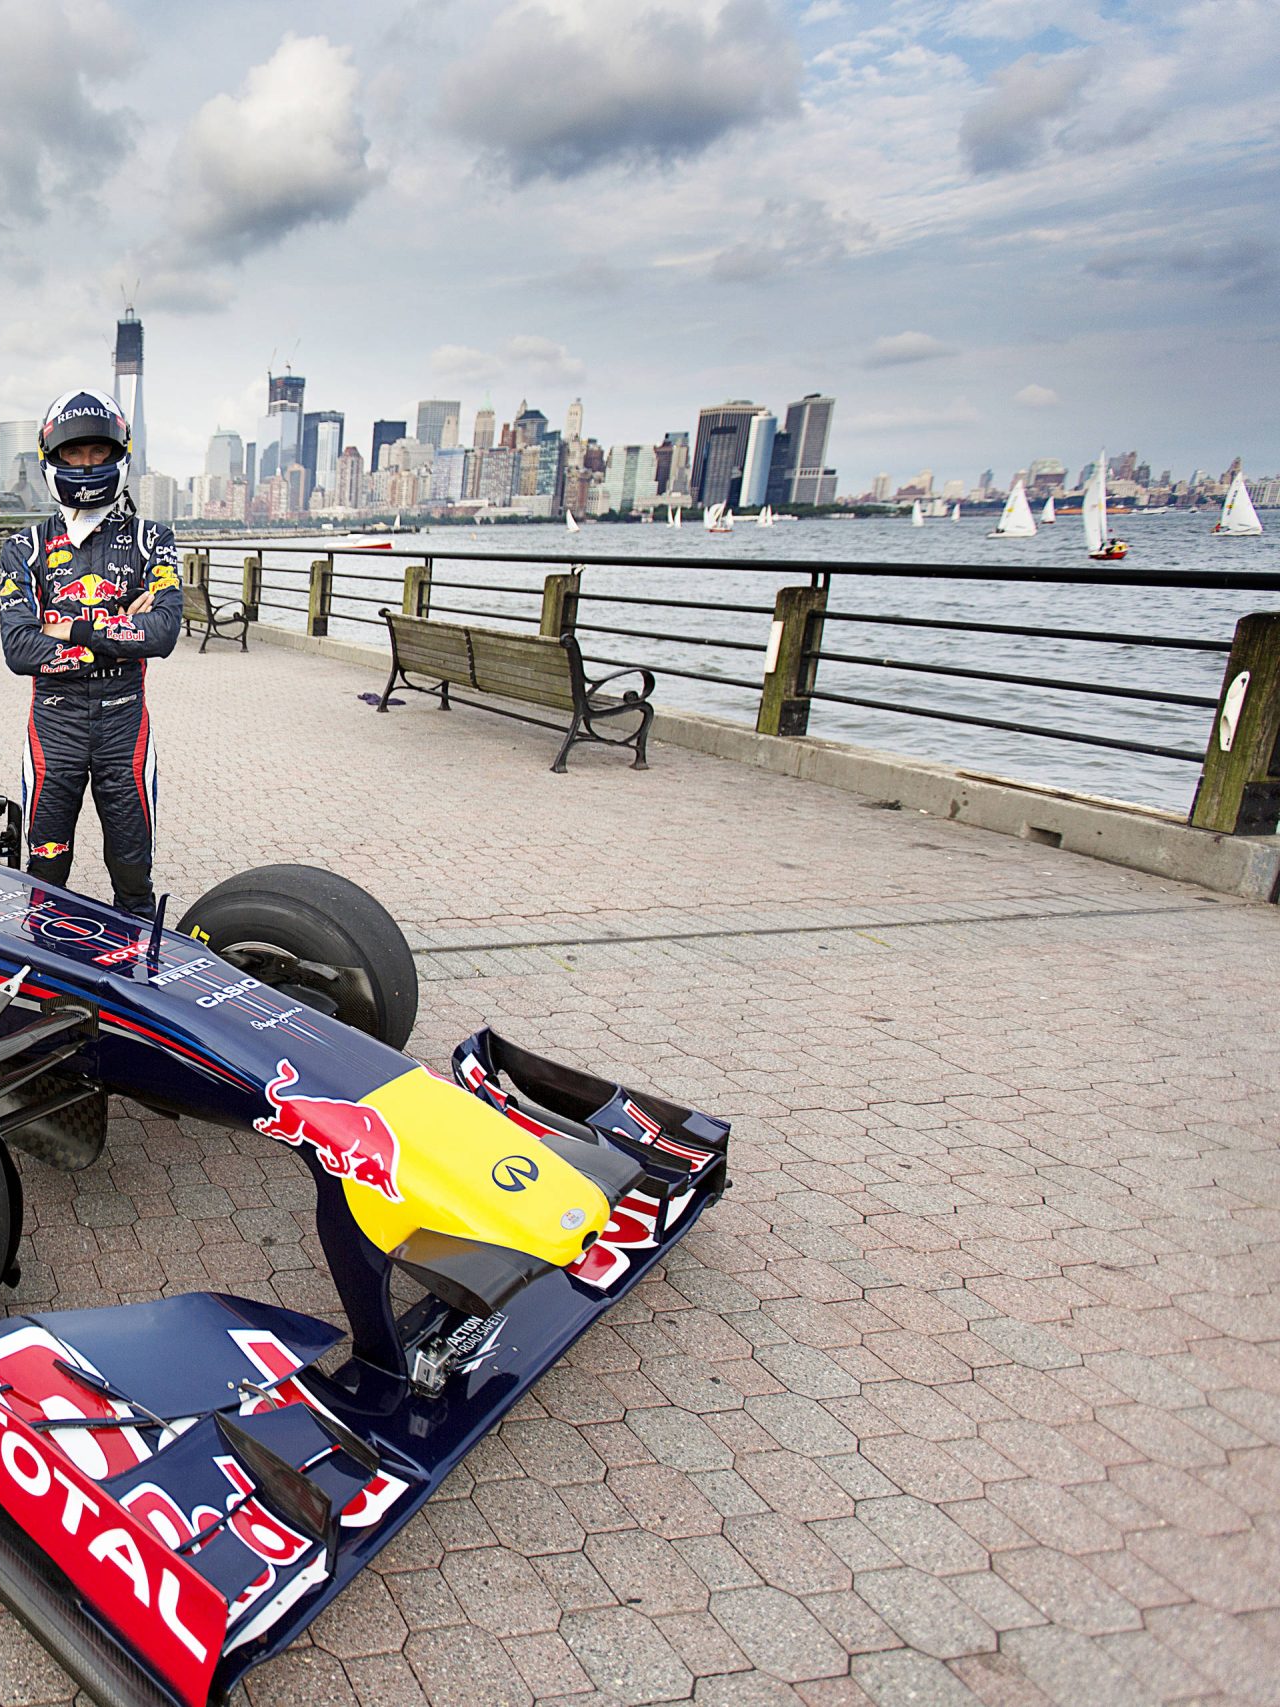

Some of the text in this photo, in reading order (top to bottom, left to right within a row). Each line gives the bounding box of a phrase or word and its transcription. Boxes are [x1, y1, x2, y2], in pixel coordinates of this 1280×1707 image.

[57, 407, 112, 424] RENAULT
[107, 628, 145, 641] Red Bull
[52, 920, 93, 936] 1
[148, 957, 217, 986] PIRELLI
[195, 978, 262, 1008] CASIO
[448, 1315, 484, 1346] ACTION
[458, 1333, 483, 1353] ROAD
[476, 1311, 505, 1336] SAFETY
